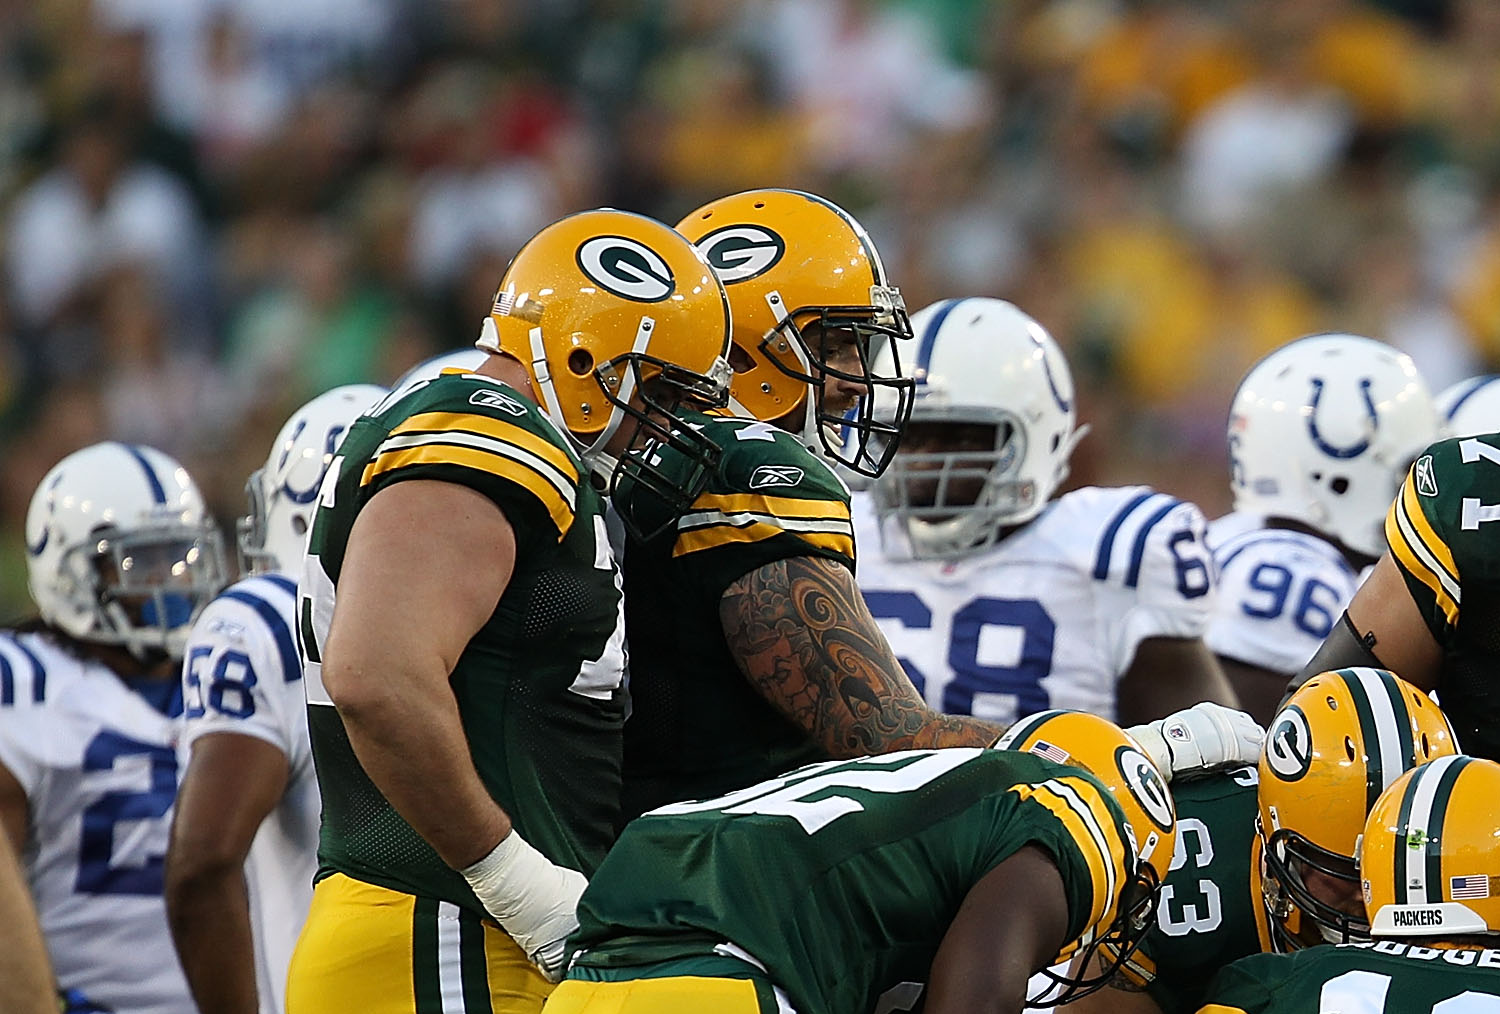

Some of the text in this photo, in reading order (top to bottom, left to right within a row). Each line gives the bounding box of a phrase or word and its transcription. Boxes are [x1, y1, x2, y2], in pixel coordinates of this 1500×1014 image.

[580, 237, 674, 302] G
[693, 228, 779, 283] G
[1168, 531, 1213, 600] 6
[1242, 562, 1343, 640] 96
[184, 646, 258, 720] 58
[1268, 709, 1309, 776] G
[74, 727, 178, 895] 2
[1120, 751, 1174, 827] G
[1157, 817, 1223, 937] 63
[1393, 908, 1443, 927] PACKERS
